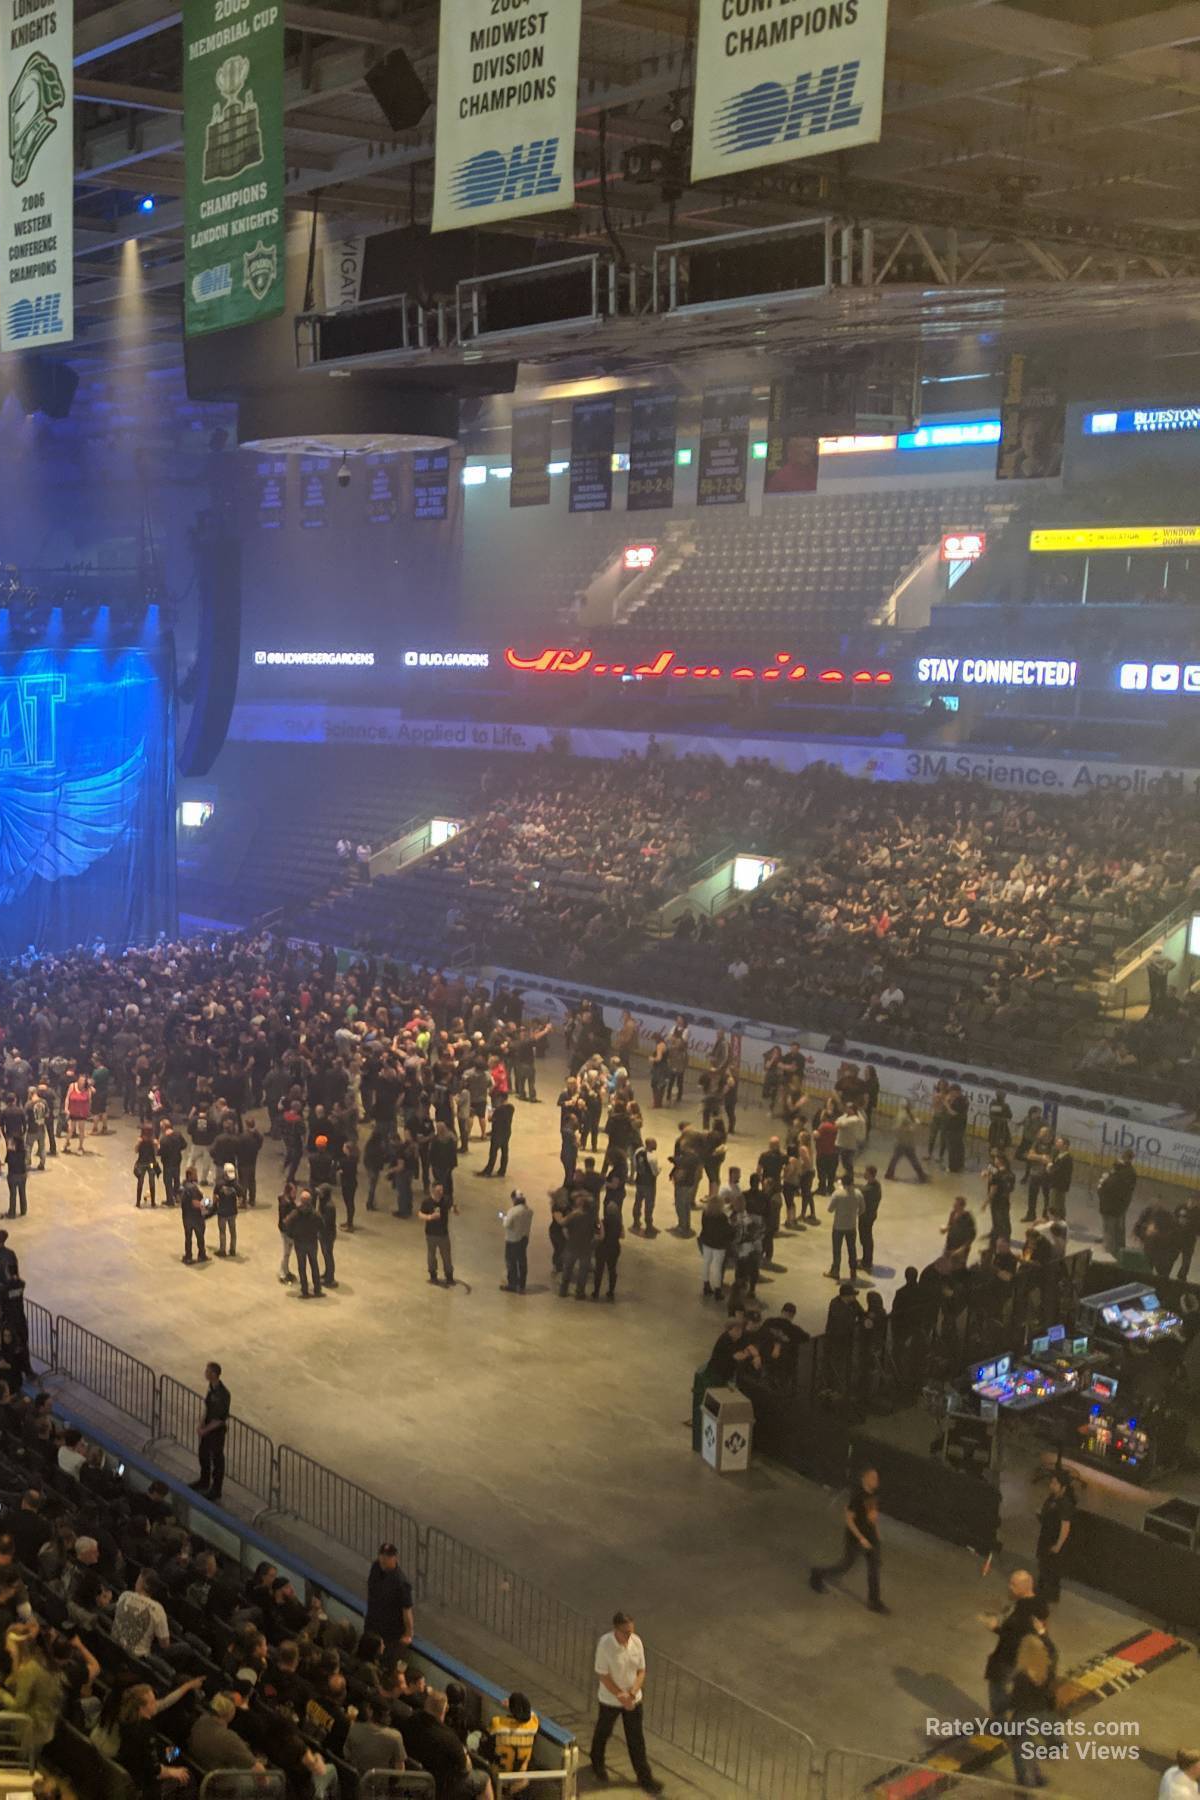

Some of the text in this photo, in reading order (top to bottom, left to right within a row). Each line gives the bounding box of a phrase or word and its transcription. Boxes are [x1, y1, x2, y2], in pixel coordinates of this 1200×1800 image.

[11, 11, 57, 50] KNIGHTS
[189, 6, 278, 60] MEMORIAL CUP
[470, 12, 549, 53] MIDWEST
[725, 0, 858, 57] CHAMPIONS
[472, 46, 545, 84] DIVISION
[459, 76, 557, 119] CHAMPIONS
[711, 60, 863, 156] OHL
[448, 137, 562, 210] OHL
[22, 192, 45, 212] 2006
[200, 182, 268, 219] CHAMPIONS
[14, 213, 52, 237] WESTERN
[191, 207, 279, 249] LONDON KNIGHTS
[9, 235, 57, 261] CONFERENCE
[10, 259, 57, 284] CHAMPIONS
[7, 293, 64, 340] OHL
[1163, 528, 1197, 538] WINDOW
[419, 652, 489, 667] BUD.GARDENS
[917, 658, 959, 682] STAY
[962, 659, 1077, 686] CONNECTED!
[400, 723, 466, 745] Applied
[471, 726, 490, 743] to
[492, 726, 527, 747] Life.
[906, 753, 948, 777] 3M
[954, 757, 1064, 787] Science.
[1102, 1121, 1161, 1156] Libro
